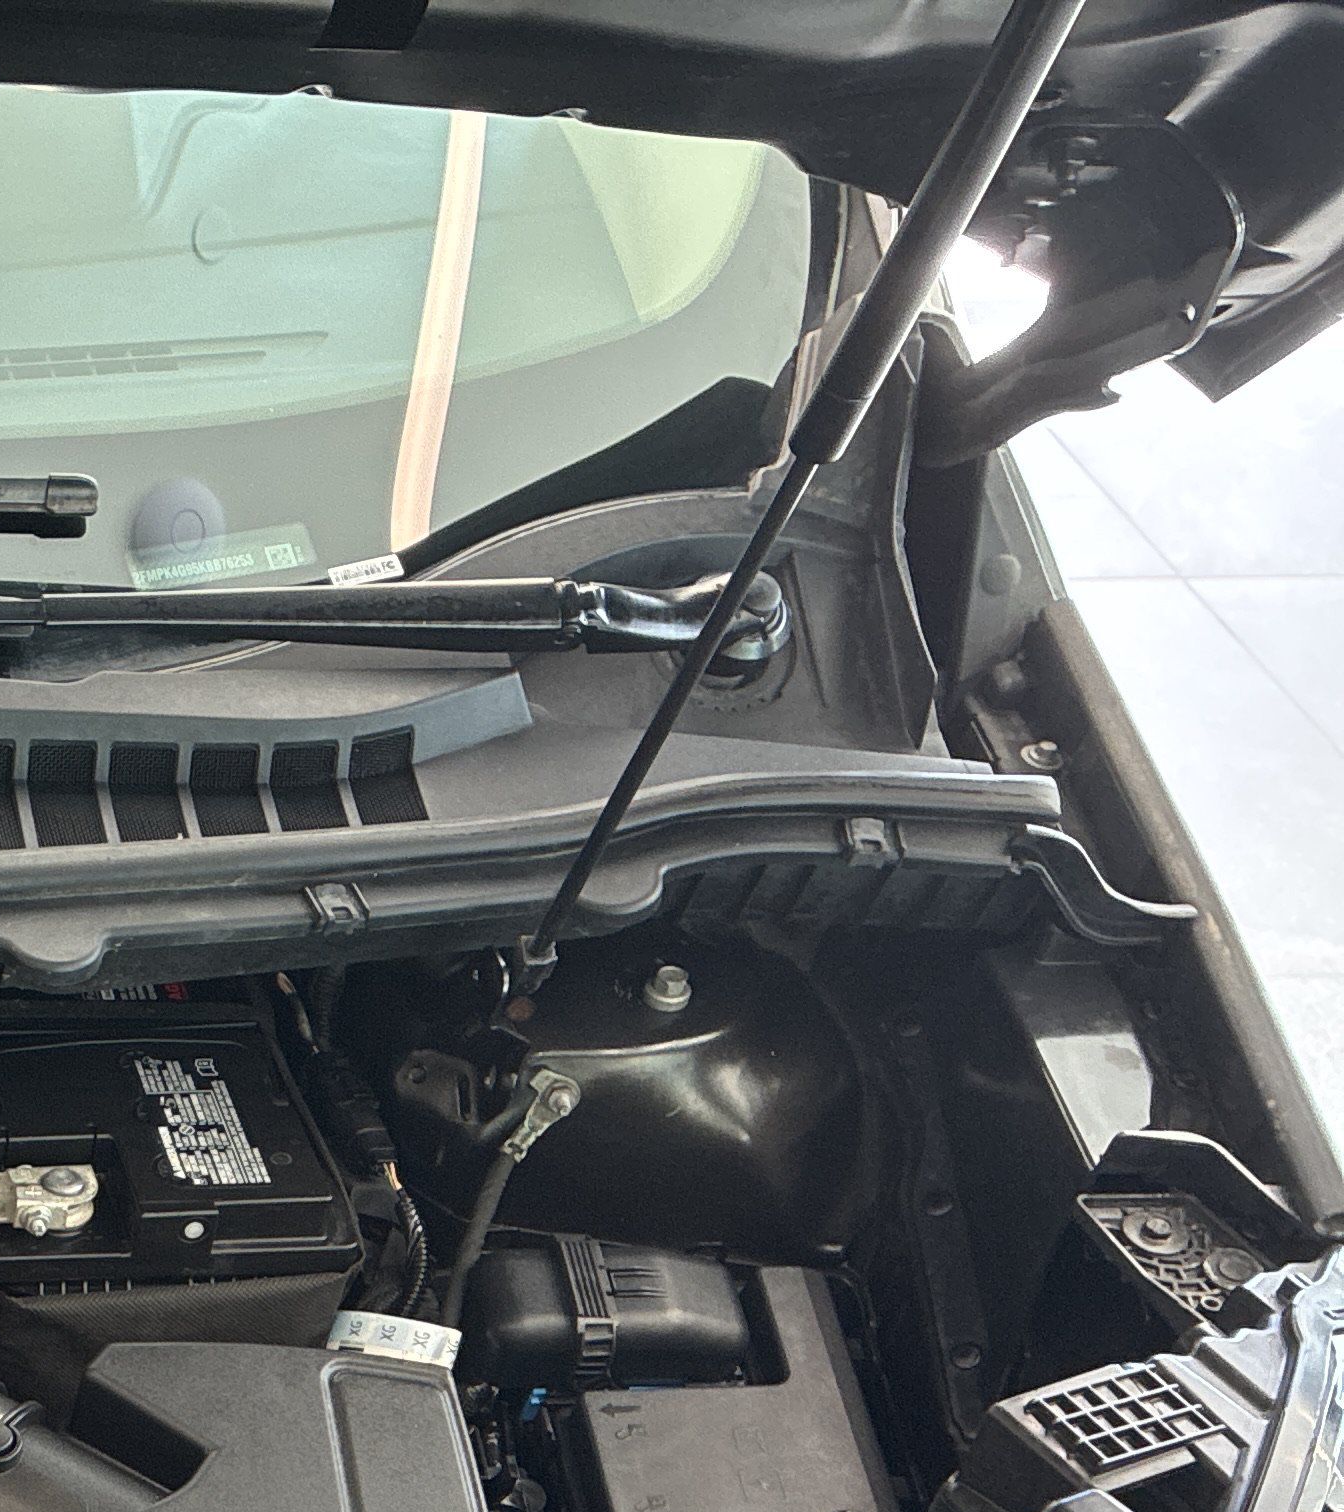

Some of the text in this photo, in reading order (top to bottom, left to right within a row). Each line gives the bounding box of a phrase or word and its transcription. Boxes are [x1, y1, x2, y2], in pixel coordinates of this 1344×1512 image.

[348, 1320, 362, 1336] XG
[380, 1324, 396, 1342] XG
[412, 1330, 430, 1349] XG
